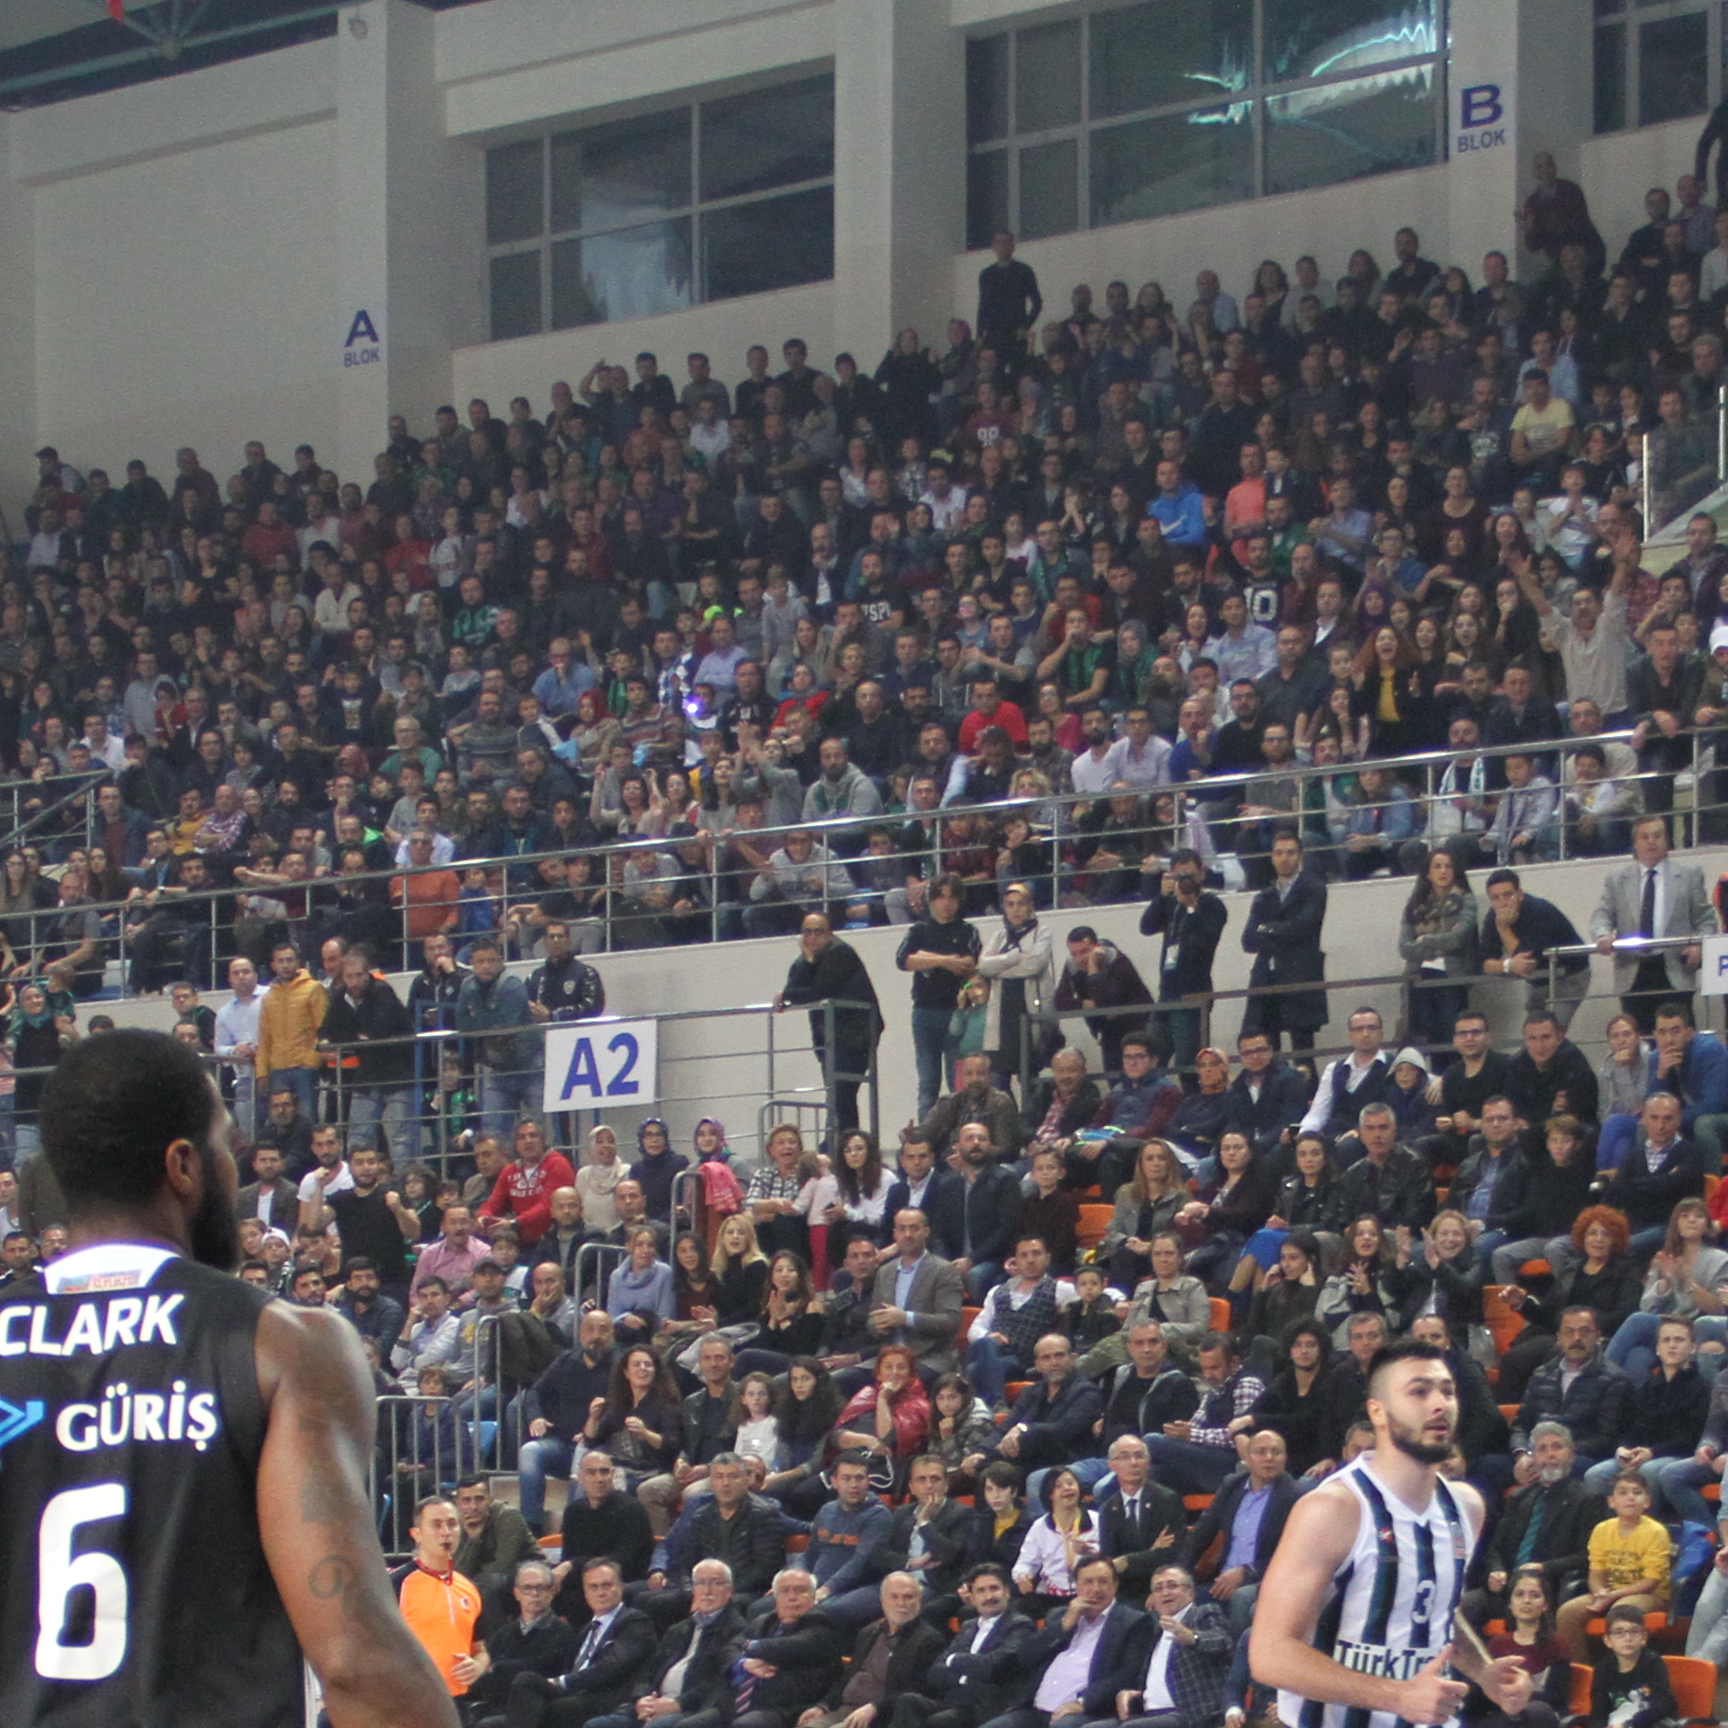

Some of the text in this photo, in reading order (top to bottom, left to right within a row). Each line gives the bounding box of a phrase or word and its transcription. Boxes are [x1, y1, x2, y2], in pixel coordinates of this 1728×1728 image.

[1461, 84, 1502, 129] B
[1458, 129, 1506, 153] BLOK
[344, 309, 380, 348] A
[343, 347, 380, 368] BLOK
[562, 1030, 641, 1100] A2
[55, 1380, 218, 1452] GÜRİŞ
[34, 1482, 128, 1681] 6
[1412, 1579, 1438, 1625] 3
